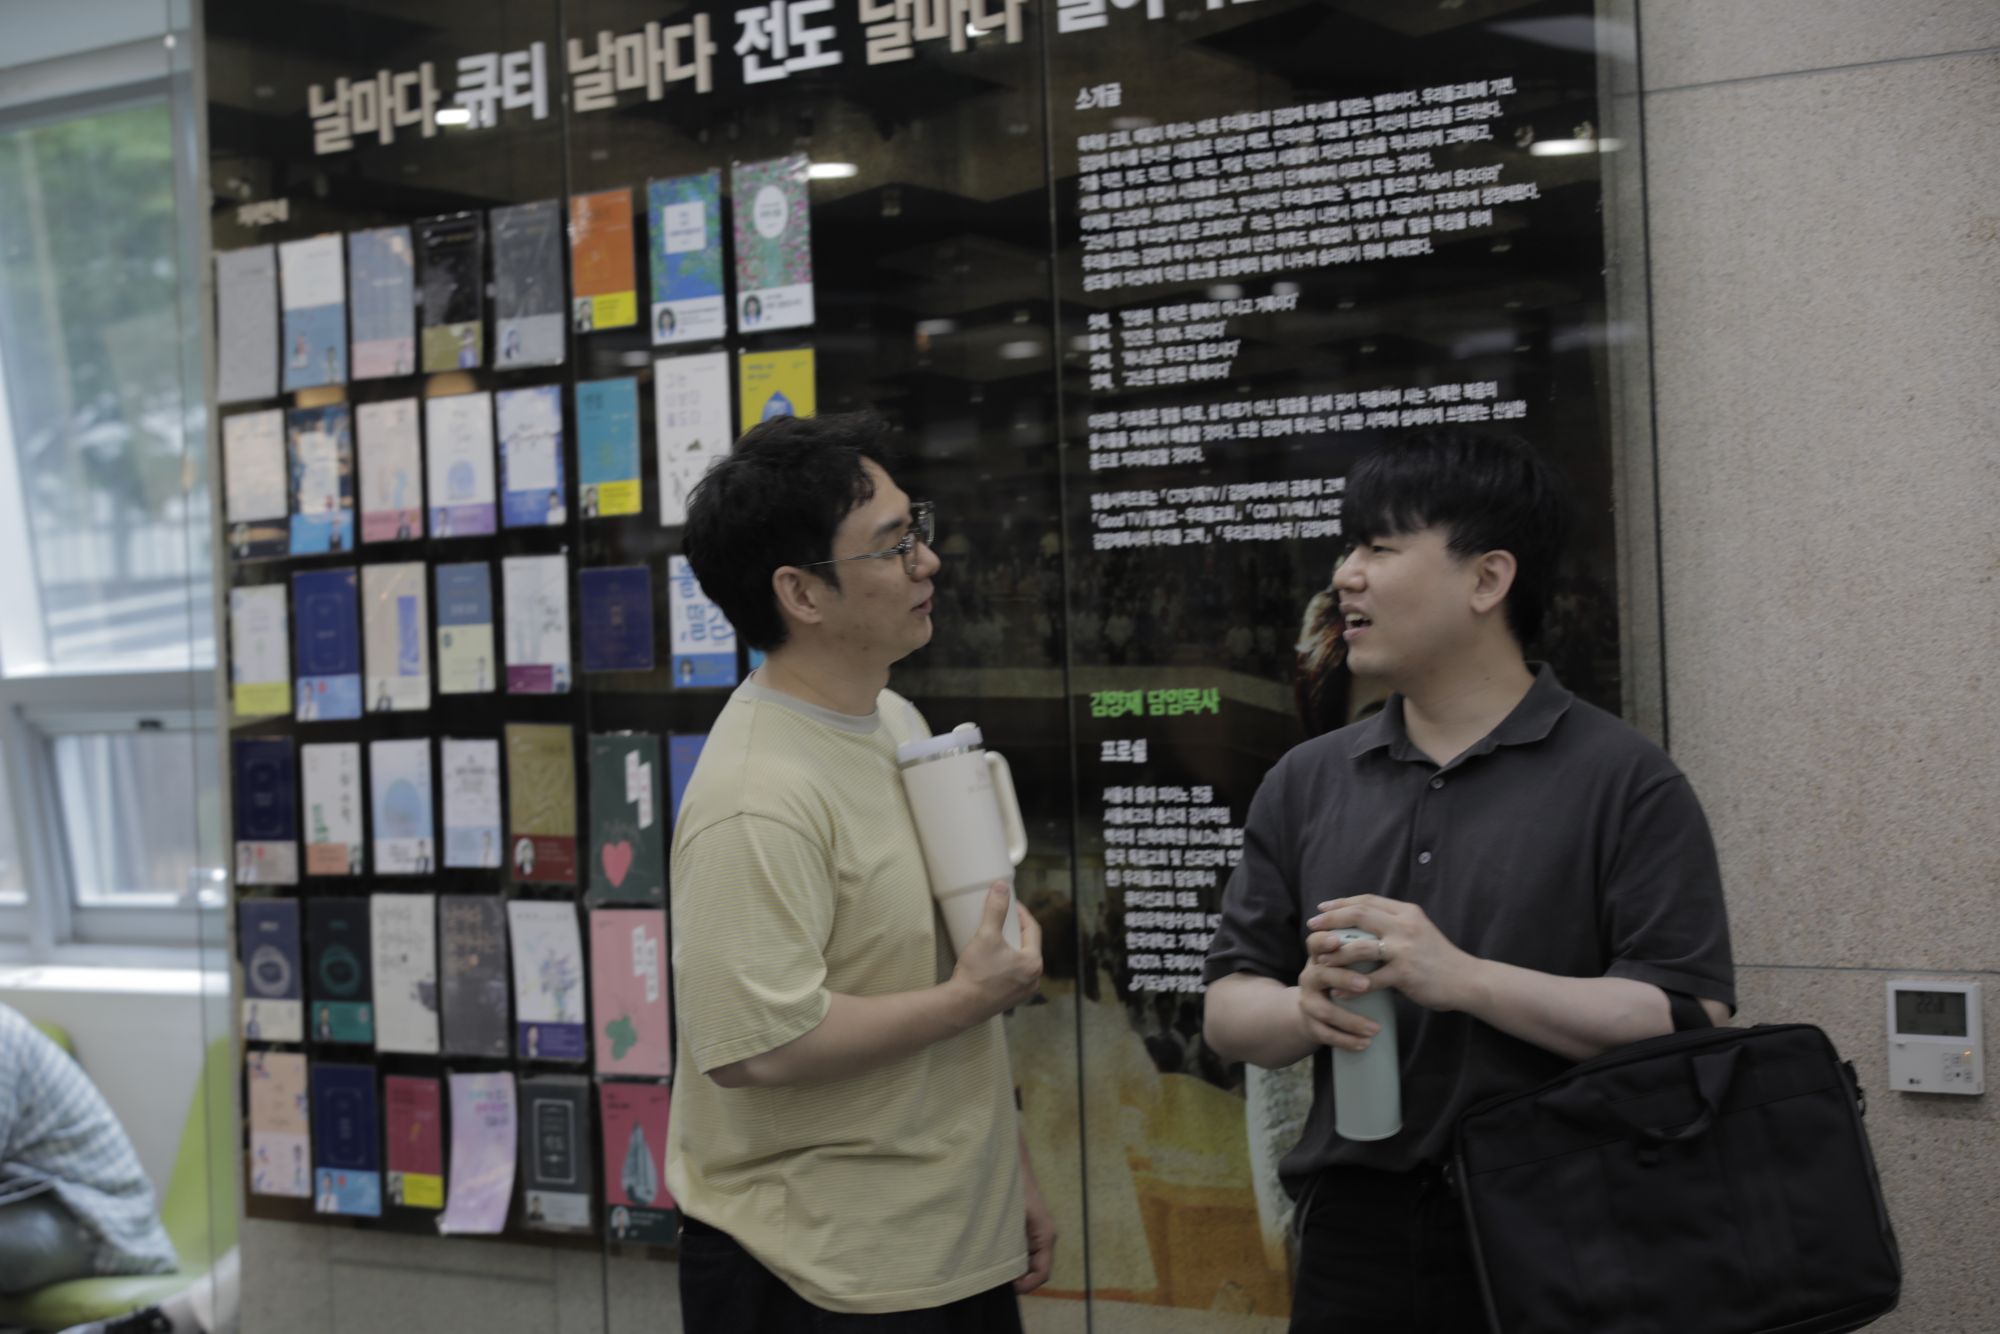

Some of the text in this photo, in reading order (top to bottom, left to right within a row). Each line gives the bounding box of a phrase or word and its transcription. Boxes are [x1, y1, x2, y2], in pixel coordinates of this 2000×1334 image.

[307, 61, 440, 155] 날마다
[453, 42, 548, 129] 큐티
[567, 13, 717, 113] 날마다
[734, 0, 842, 84] 전도
[858, 0, 1024, 65] 날마다
[1090, 687, 1221, 718] 김양재 담임목사
[1100, 738, 1148, 763] 프로필
